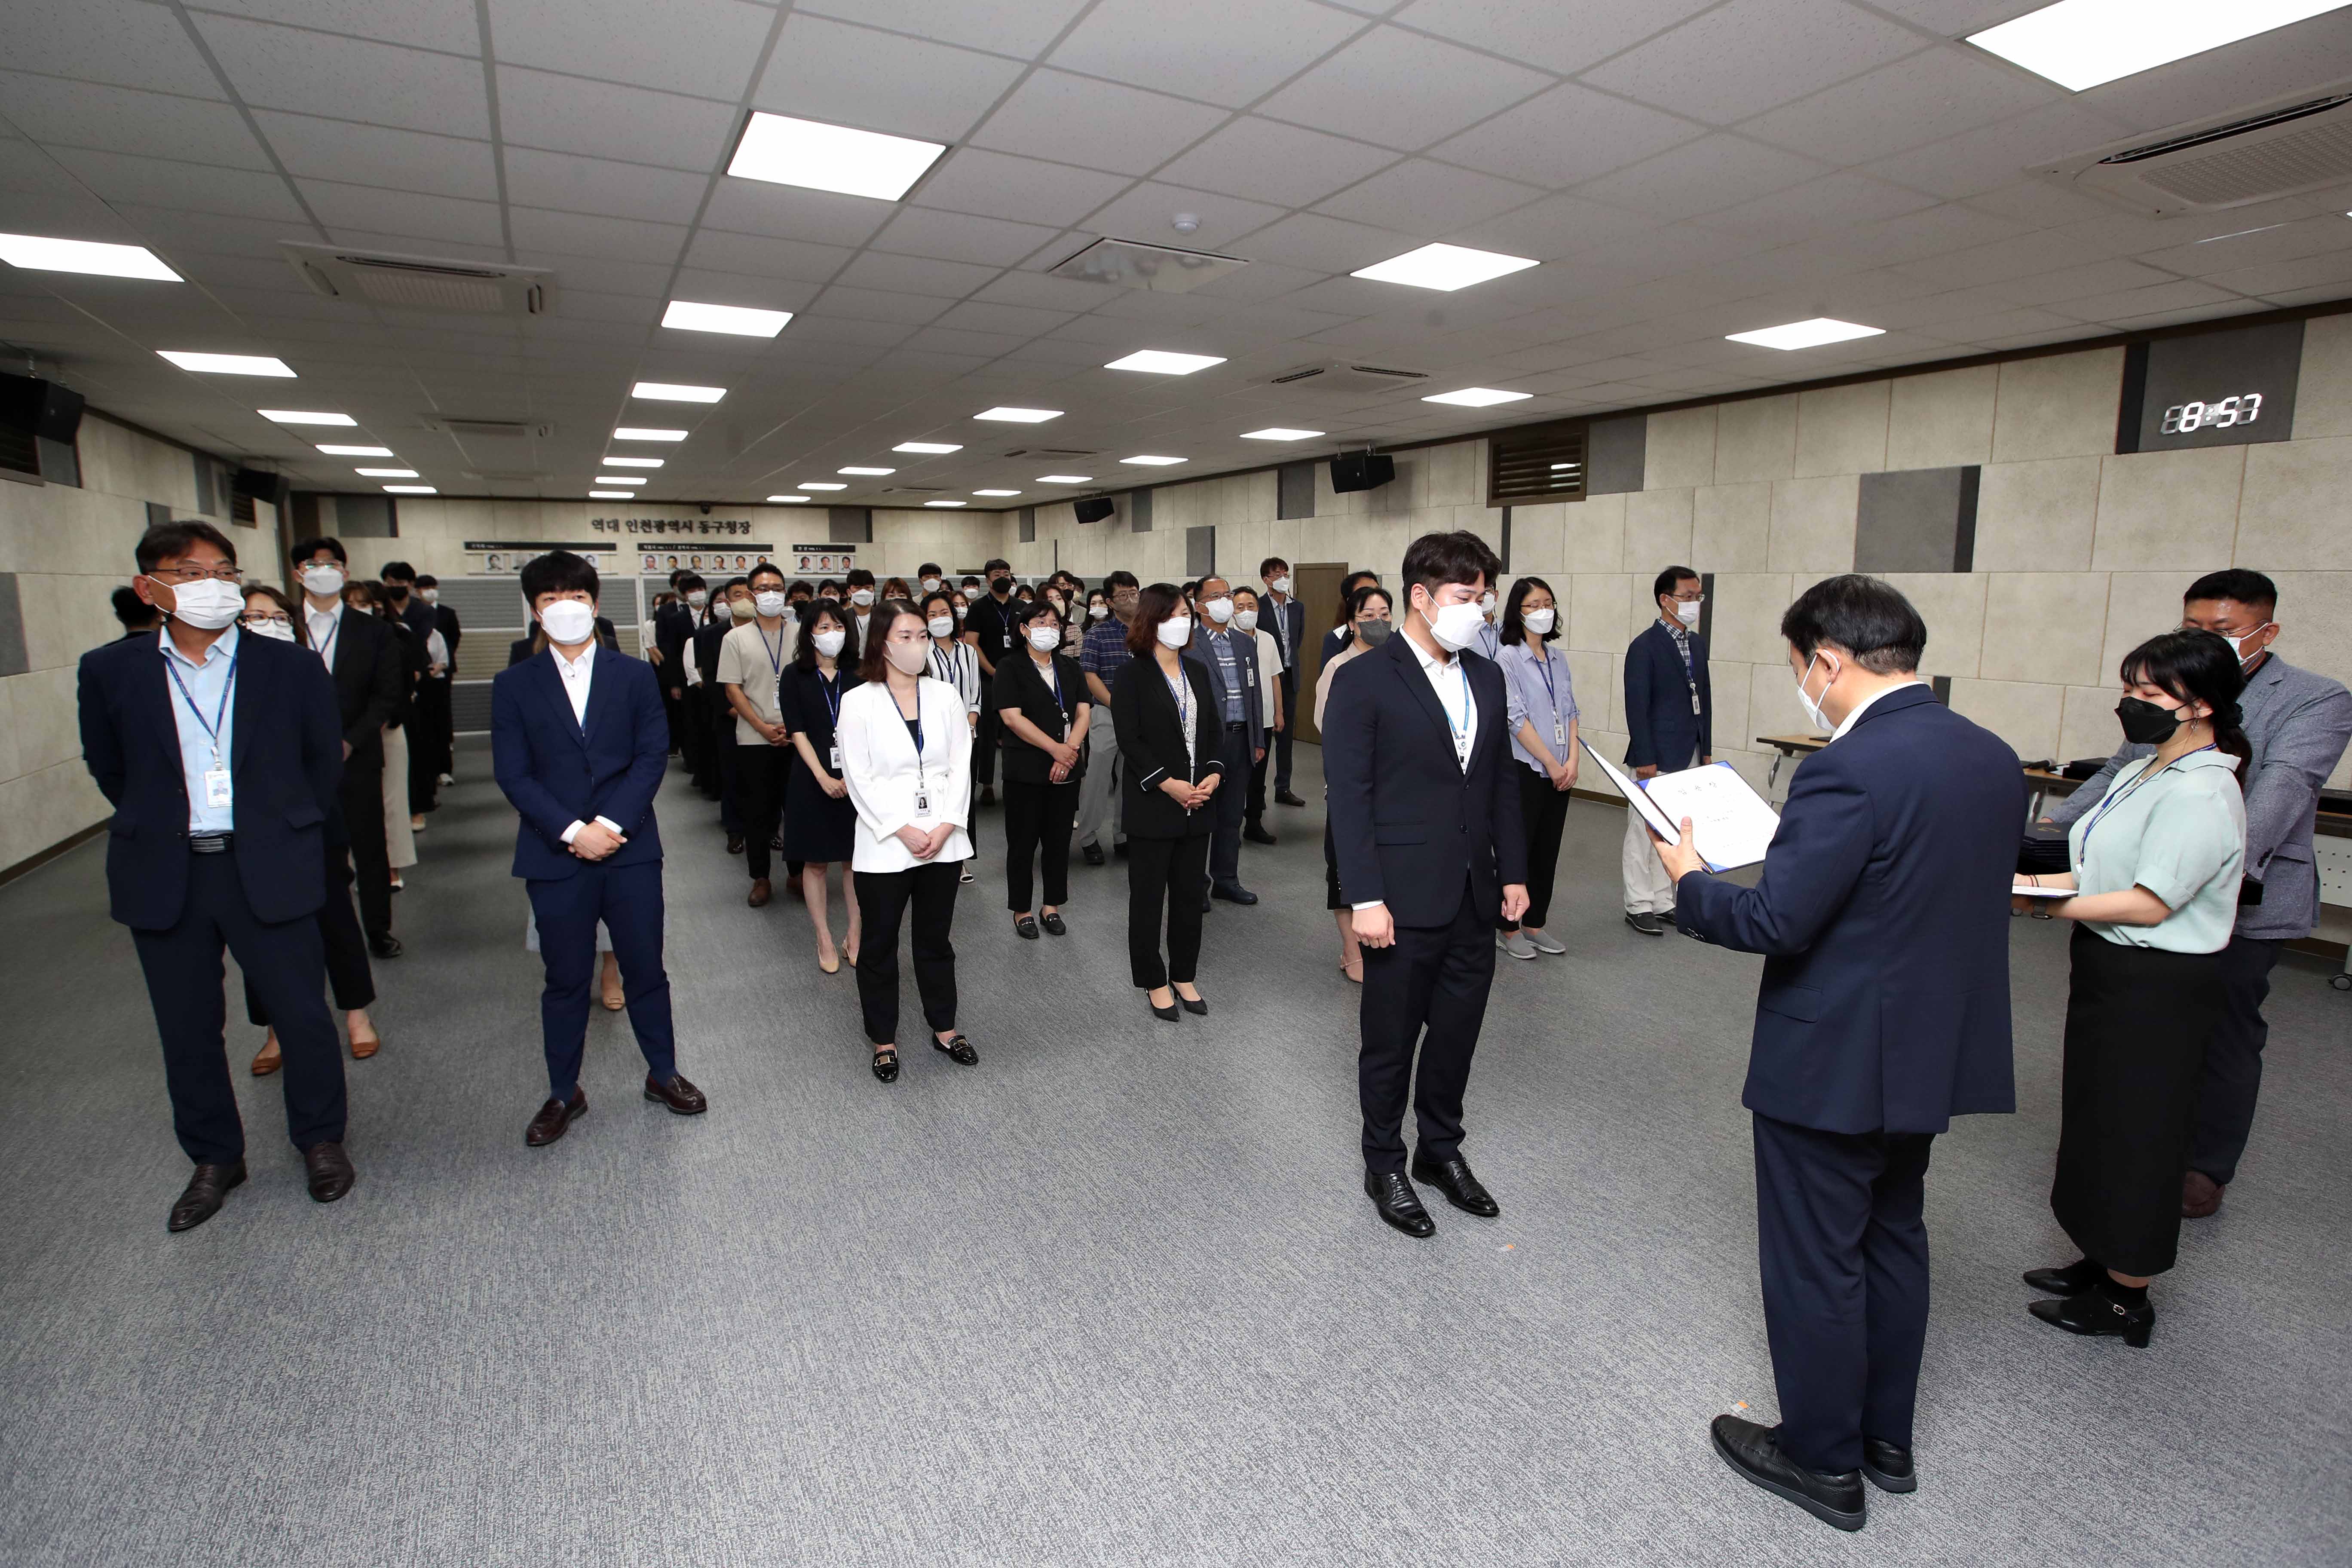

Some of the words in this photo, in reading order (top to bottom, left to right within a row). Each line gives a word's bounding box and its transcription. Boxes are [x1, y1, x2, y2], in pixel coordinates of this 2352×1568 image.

[2178, 392, 2262, 432] 8:57
[591, 518, 619, 533] 역대
[626, 519, 693, 533] 인천광역시
[698, 520, 751, 534] 동구청장
